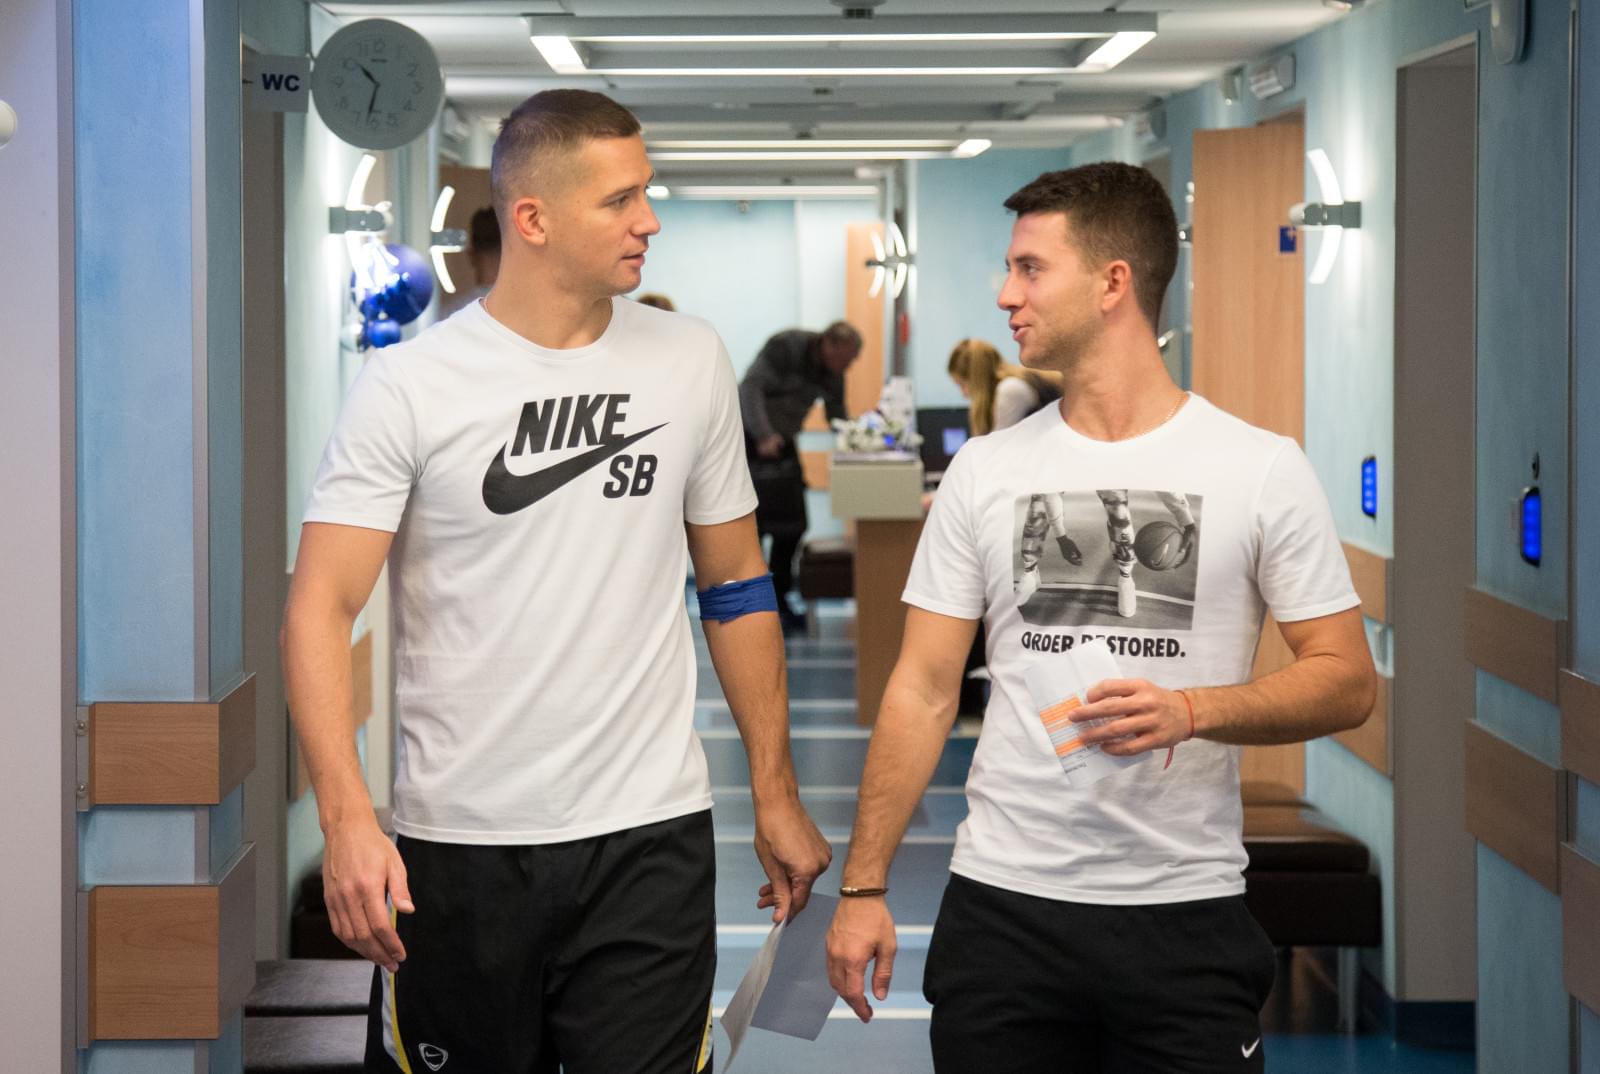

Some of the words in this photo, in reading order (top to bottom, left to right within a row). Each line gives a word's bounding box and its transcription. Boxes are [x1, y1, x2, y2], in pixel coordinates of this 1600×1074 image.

[261, 73, 300, 92] WC
[510, 393, 631, 456] NIKE
[602, 454, 658, 499] SB
[1021, 631, 1075, 653] ORDER
[1081, 634, 1186, 657] STORED.
